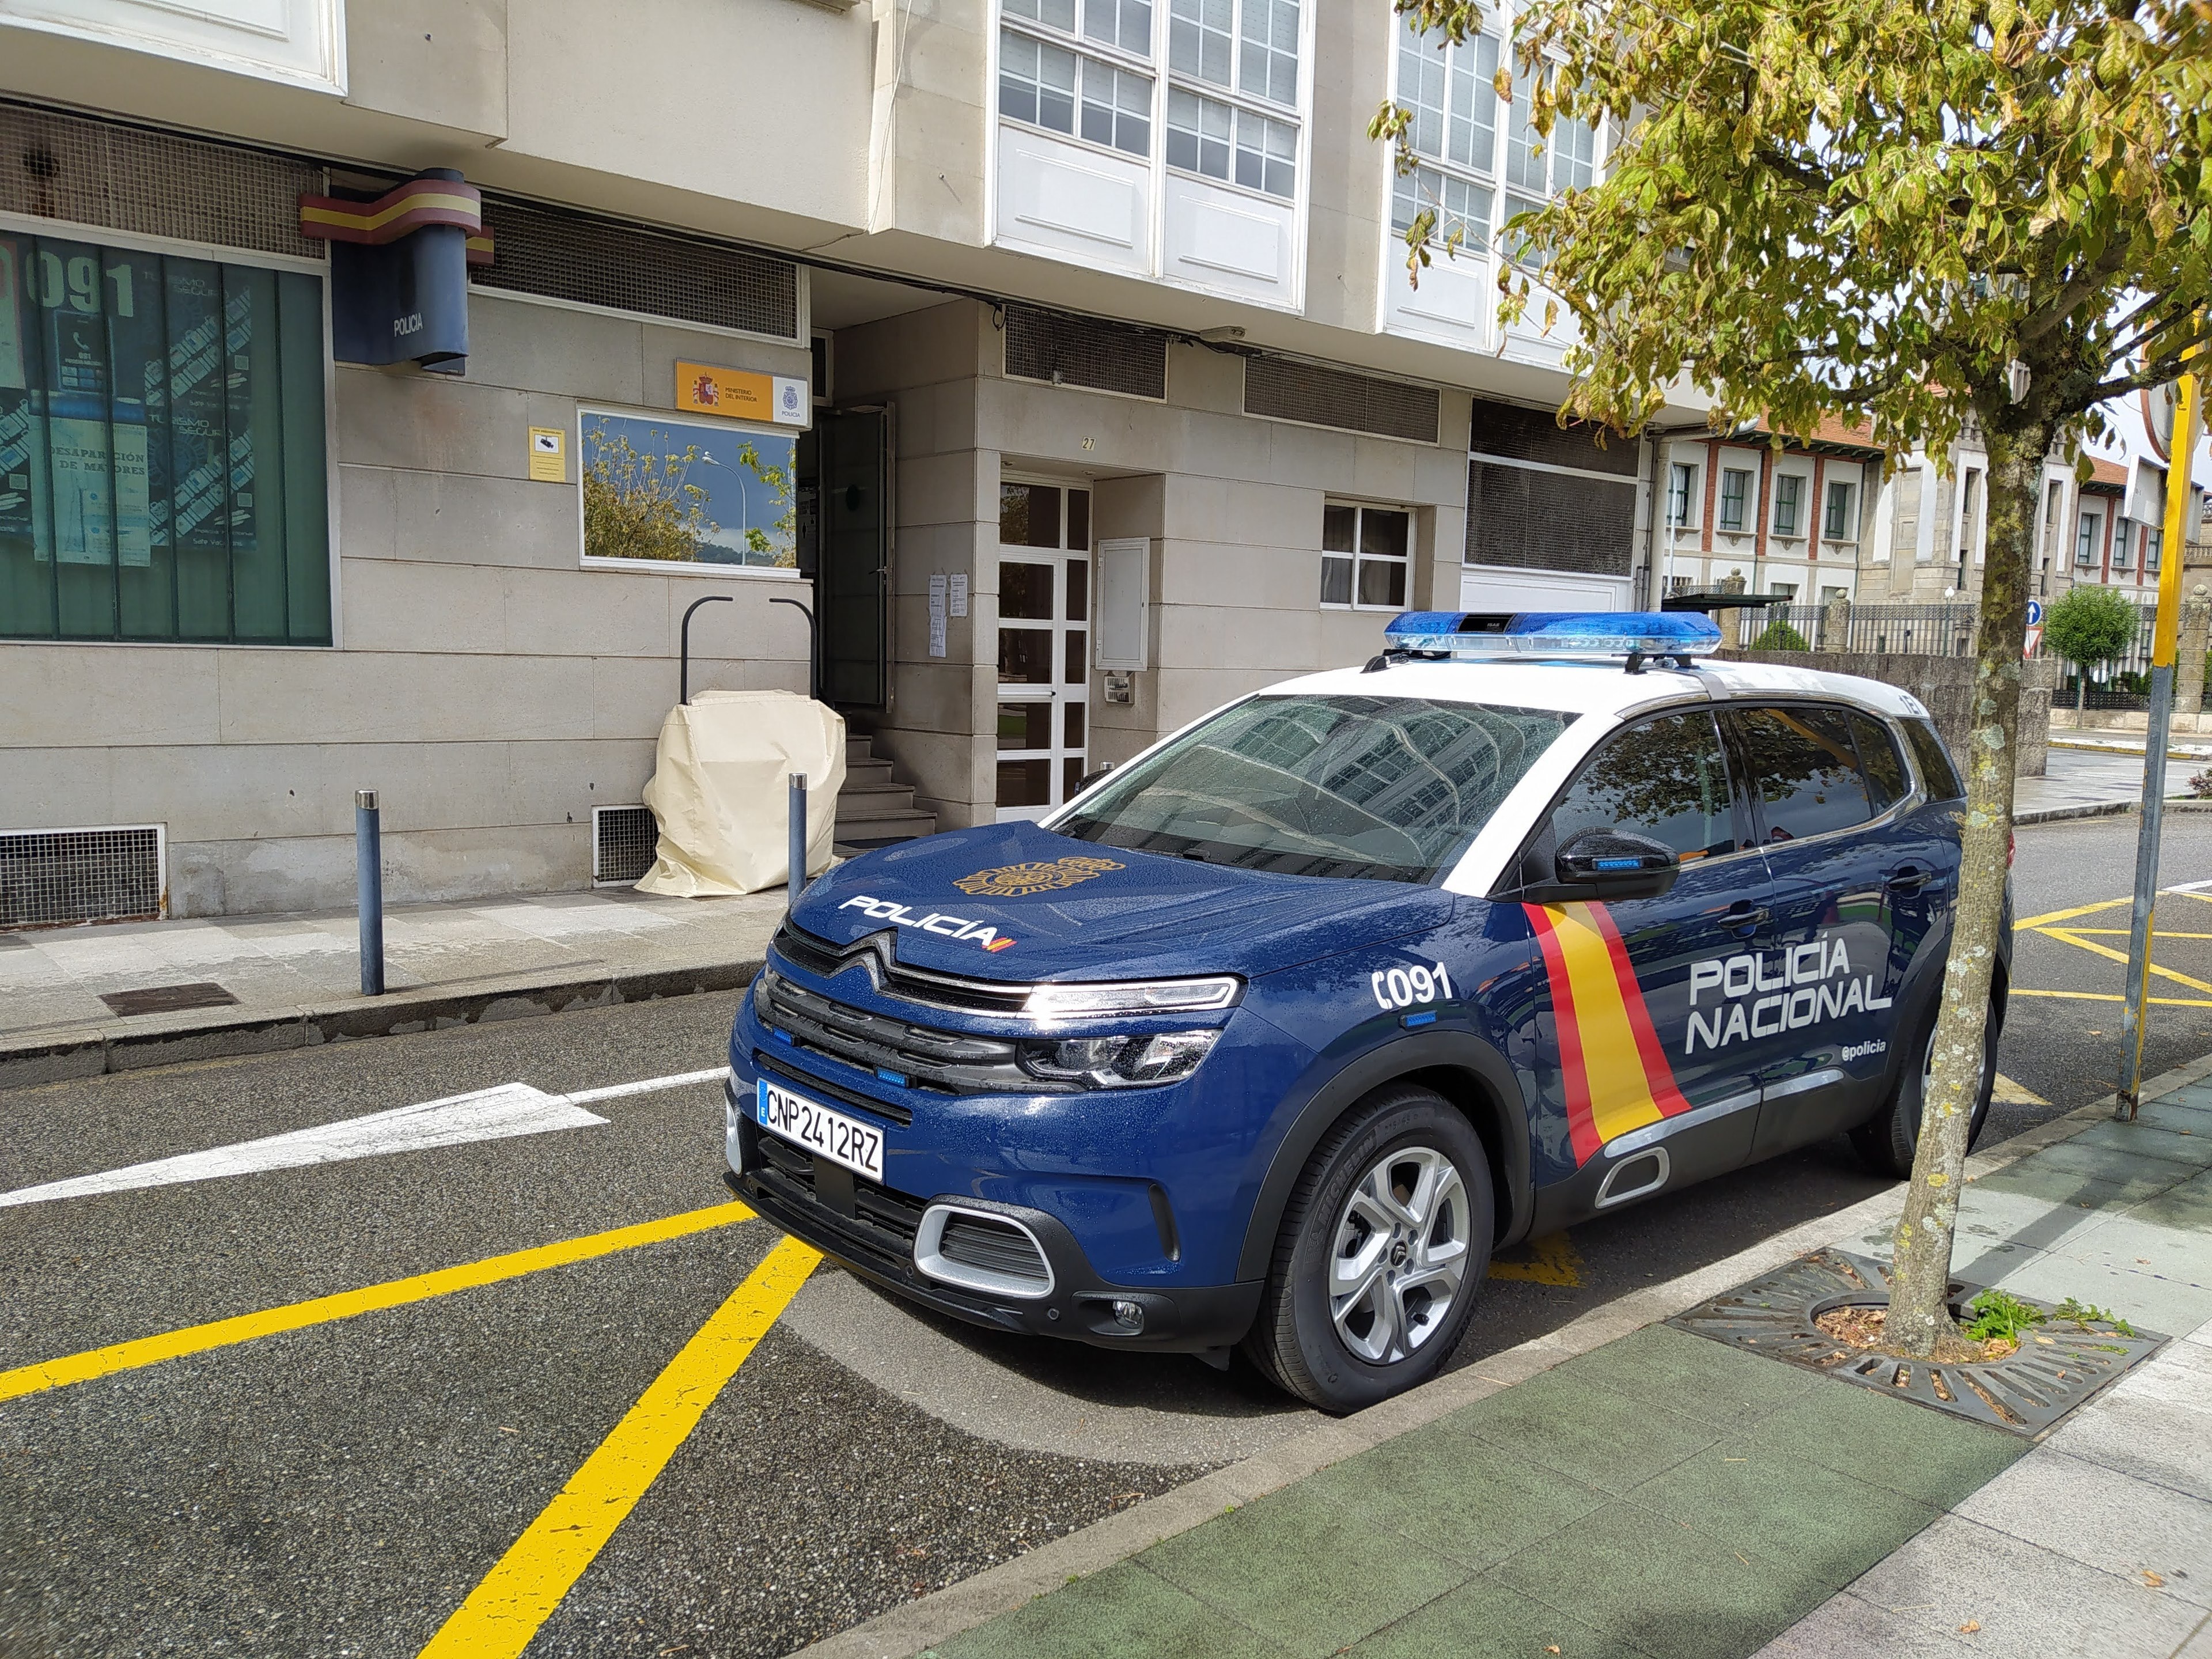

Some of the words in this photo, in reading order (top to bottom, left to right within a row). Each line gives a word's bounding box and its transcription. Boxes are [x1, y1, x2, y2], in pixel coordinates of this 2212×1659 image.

[26, 251, 134, 317] 091
[394, 312, 423, 337] POLICIA
[725, 387, 752, 395] MINISTERIO
[147, 414, 210, 428] TUISMO
[50, 446, 145, 463] ESAPARCIÓN
[1082, 437, 1095, 449] 27
[59, 460, 78, 469] DE
[84, 463, 145, 475] MAORES
[838, 895, 998, 946] POLICÍA
[1689, 931, 1851, 1006] POLICÍA
[1387, 961, 1453, 1008] 091
[1685, 974, 1892, 1055] NACIONAL
[1842, 1039, 1887, 1062] @policia
[760, 1107, 766, 1118] E
[1318, 1134, 1376, 1226] MICHELIN
